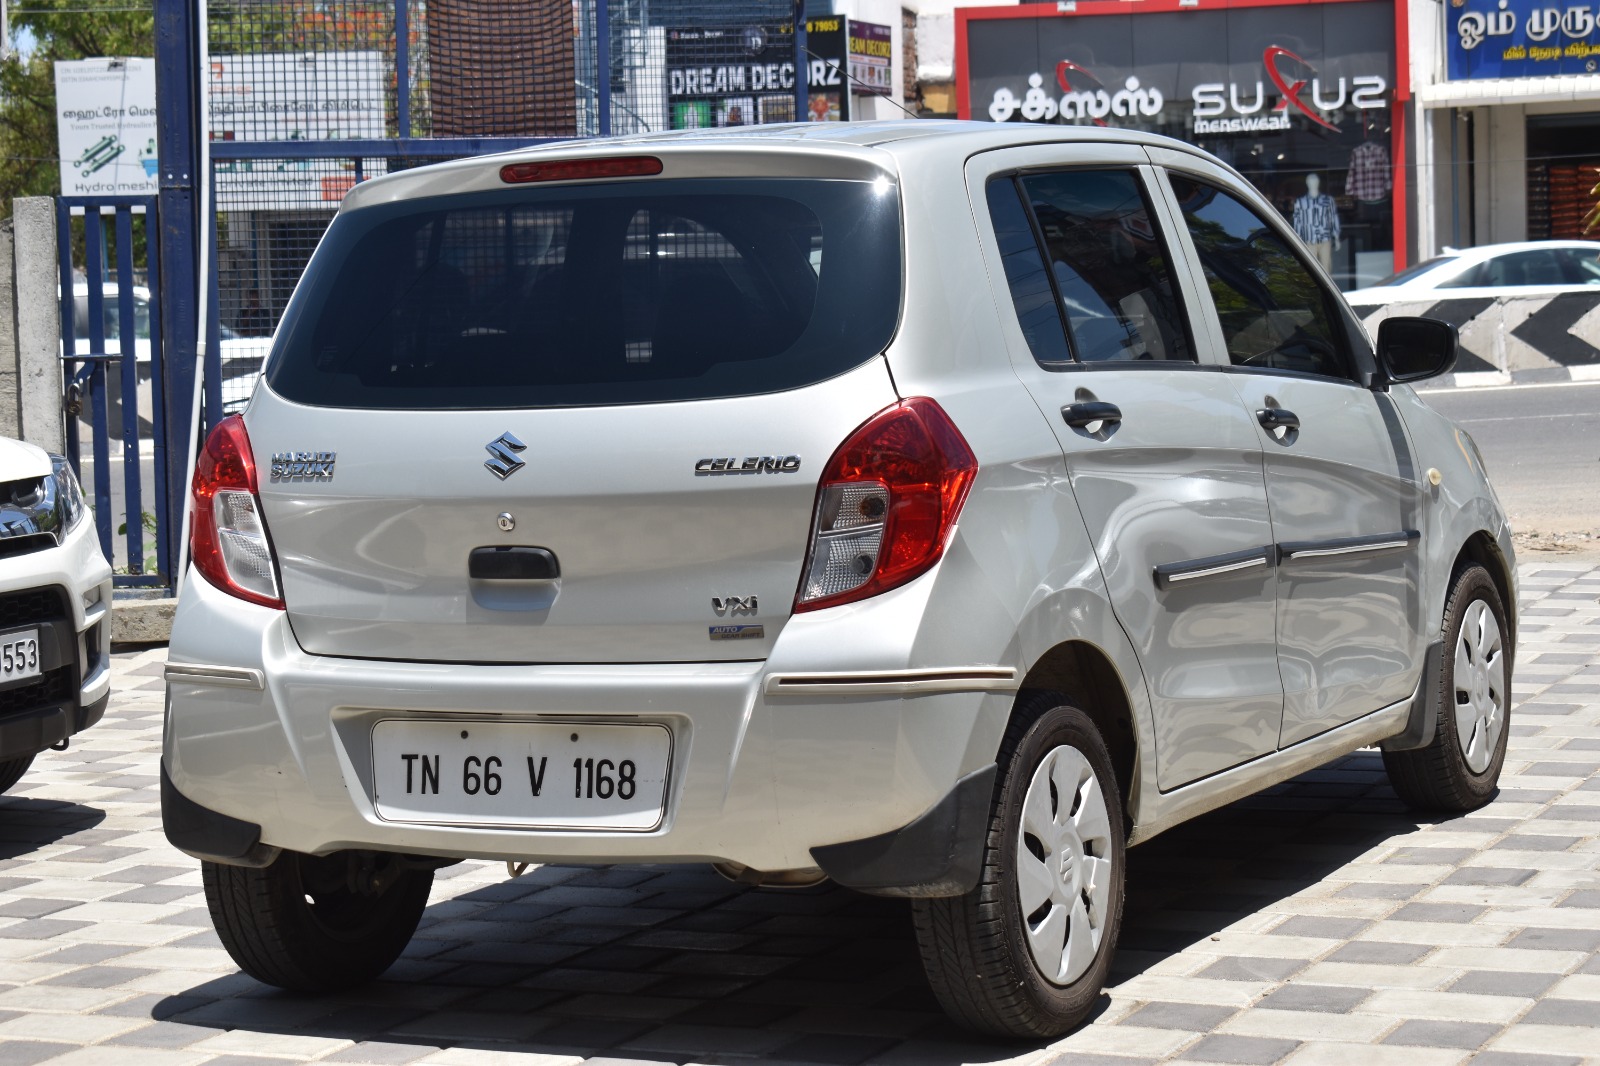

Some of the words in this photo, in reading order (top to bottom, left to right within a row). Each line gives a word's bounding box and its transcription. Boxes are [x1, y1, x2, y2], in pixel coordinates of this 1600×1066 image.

[1525, 6, 1600, 42] முரு
[671, 66, 746, 95] DREAM
[752, 58, 841, 91] DECRZ
[75, 182, 115, 194] Hydro
[117, 180, 158, 191] meshi
[271, 450, 337, 462] MARUTI
[694, 454, 802, 474] CELERIO
[269, 462, 335, 478] SUZUKI
[712, 626, 738, 634] AUTO
[0, 639, 37, 673] 553
[401, 753, 440, 795] TN
[463, 755, 503, 796] 66
[526, 756, 548, 797] V
[573, 757, 637, 800] 1168
